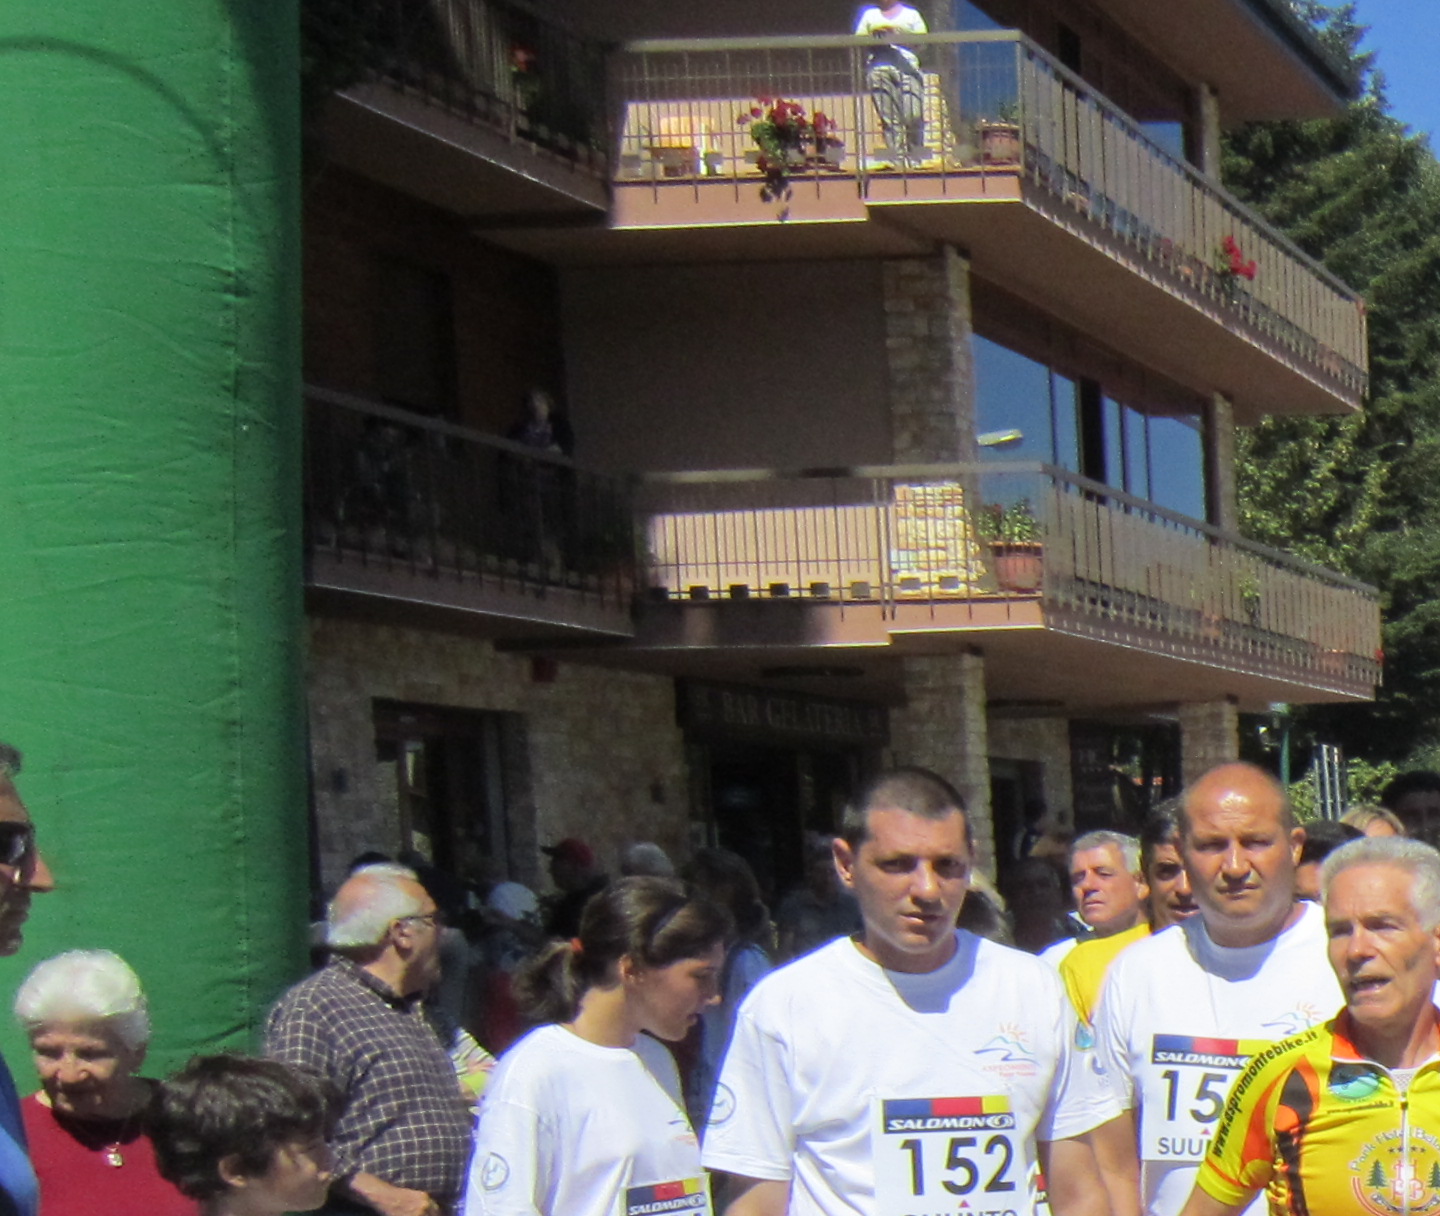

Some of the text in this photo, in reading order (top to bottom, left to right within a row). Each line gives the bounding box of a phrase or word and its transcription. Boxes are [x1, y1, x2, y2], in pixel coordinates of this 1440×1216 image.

[723, 691, 754, 725] BAR
[1154, 1051, 1237, 1066] SALOMON
[1161, 1070, 1228, 1123] 15
[1212, 1031, 1318, 1157] www.aspromontebike.it
[888, 1117, 986, 1131] SALOMON
[901, 1134, 1016, 1196] 152
[628, 1195, 692, 1216] SALOMON
